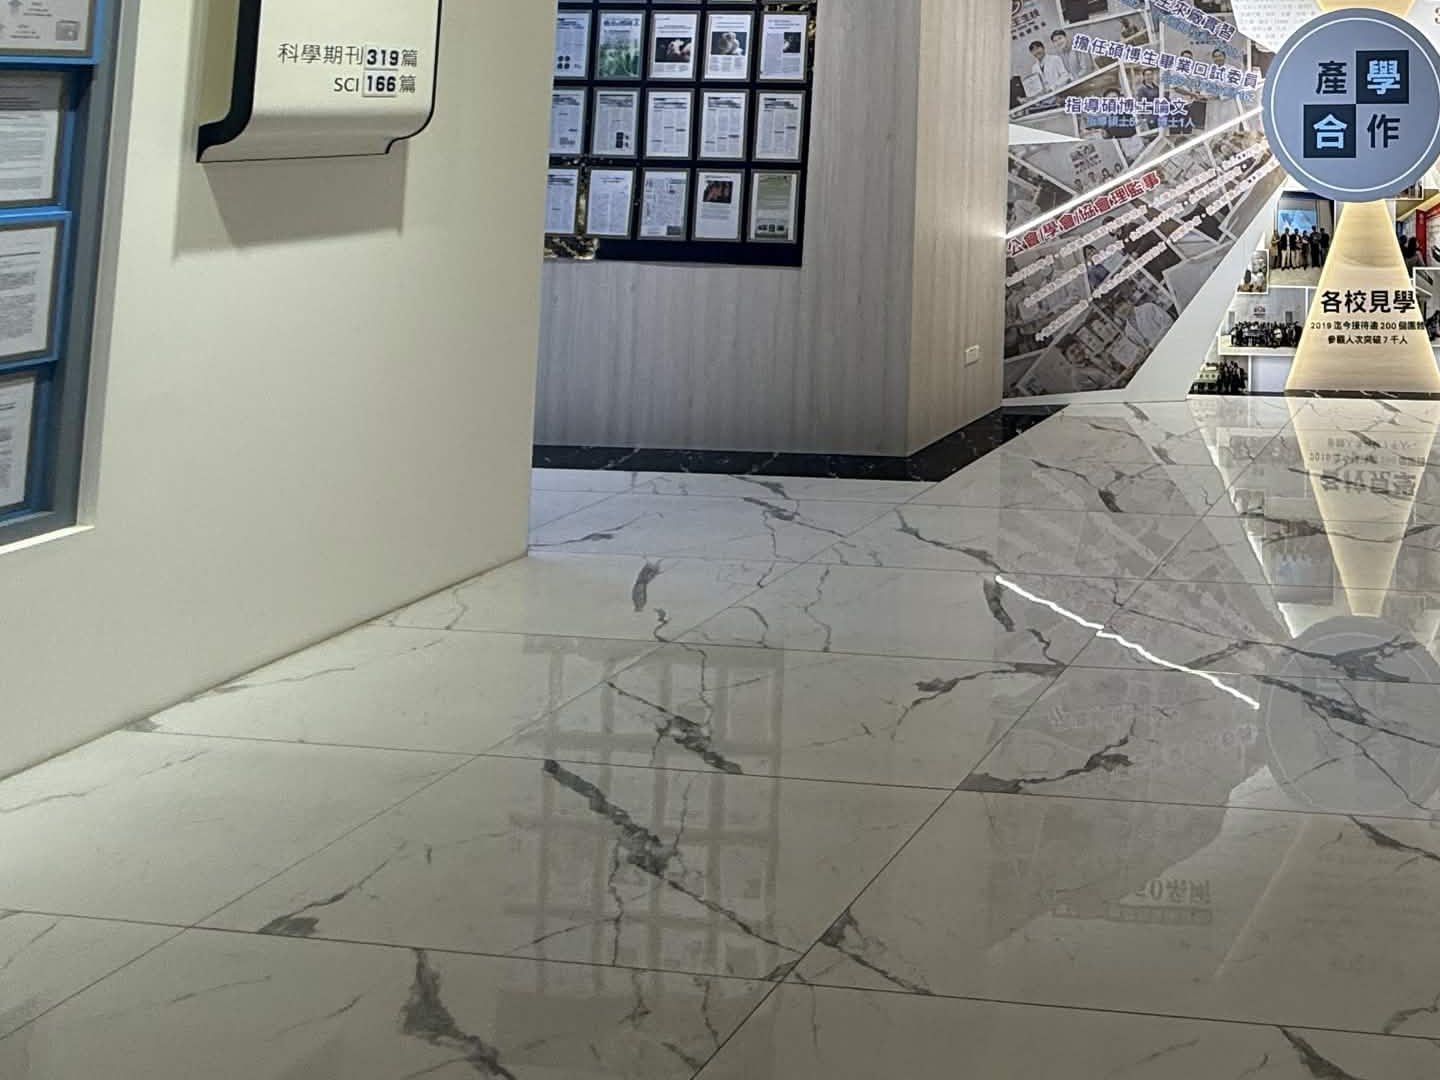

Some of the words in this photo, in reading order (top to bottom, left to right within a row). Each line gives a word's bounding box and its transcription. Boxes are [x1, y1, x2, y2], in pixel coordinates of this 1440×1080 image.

[278, 43, 418, 67] 科學期刊319篇
[333, 77, 359, 93] SCI
[1065, 97, 1189, 116] 指導碩博士論文
[1321, 289, 1416, 314] 各校見學
